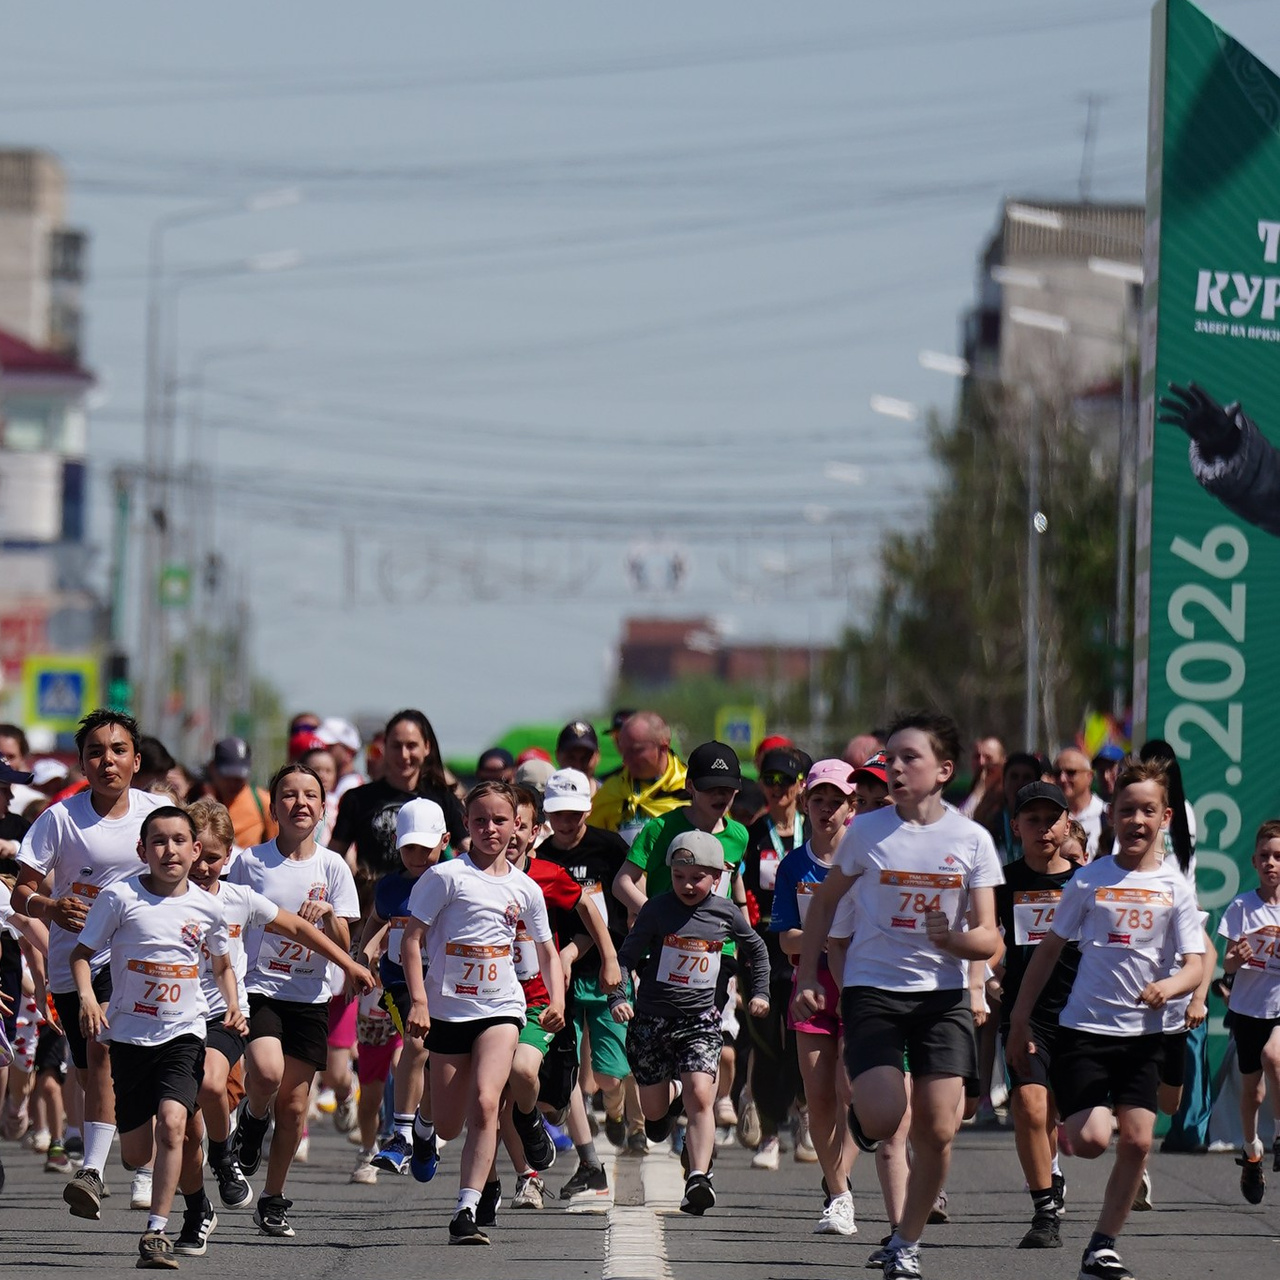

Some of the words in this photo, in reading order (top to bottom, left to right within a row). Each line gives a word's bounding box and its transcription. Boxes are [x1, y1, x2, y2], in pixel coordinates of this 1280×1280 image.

[899, 892, 941, 914] 784
[1032, 909, 1056, 927] 74
[1115, 908, 1154, 930] 783
[463, 962, 498, 982] 718
[676, 954, 709, 973] 770
[143, 980, 182, 1003] 720
